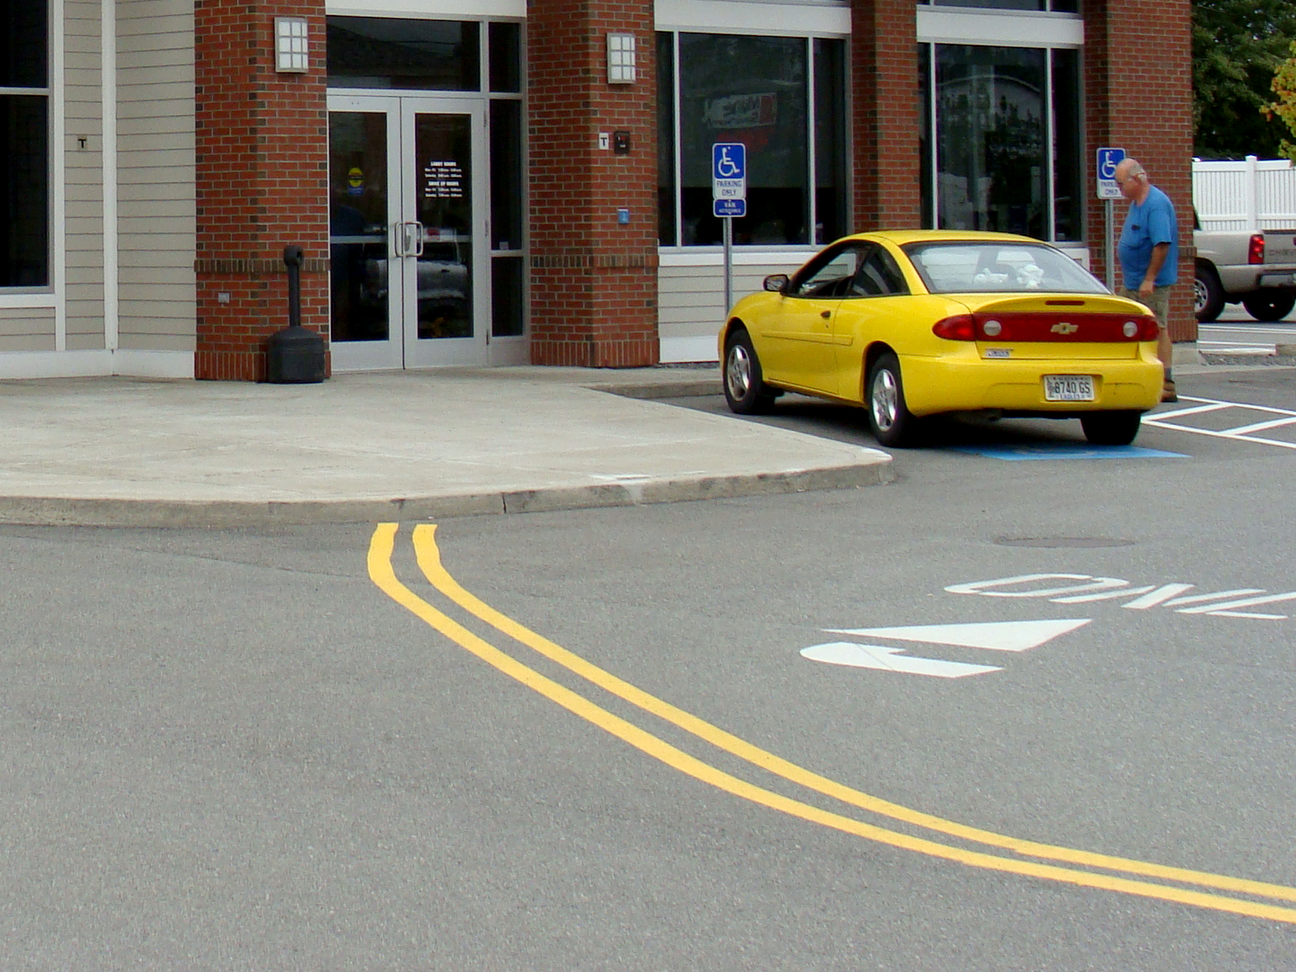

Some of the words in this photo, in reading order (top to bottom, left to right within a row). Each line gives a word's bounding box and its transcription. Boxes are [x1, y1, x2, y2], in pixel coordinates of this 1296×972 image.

[77, 138, 88, 149] T
[600, 137, 607, 147] T
[717, 180, 742, 188] PARKING
